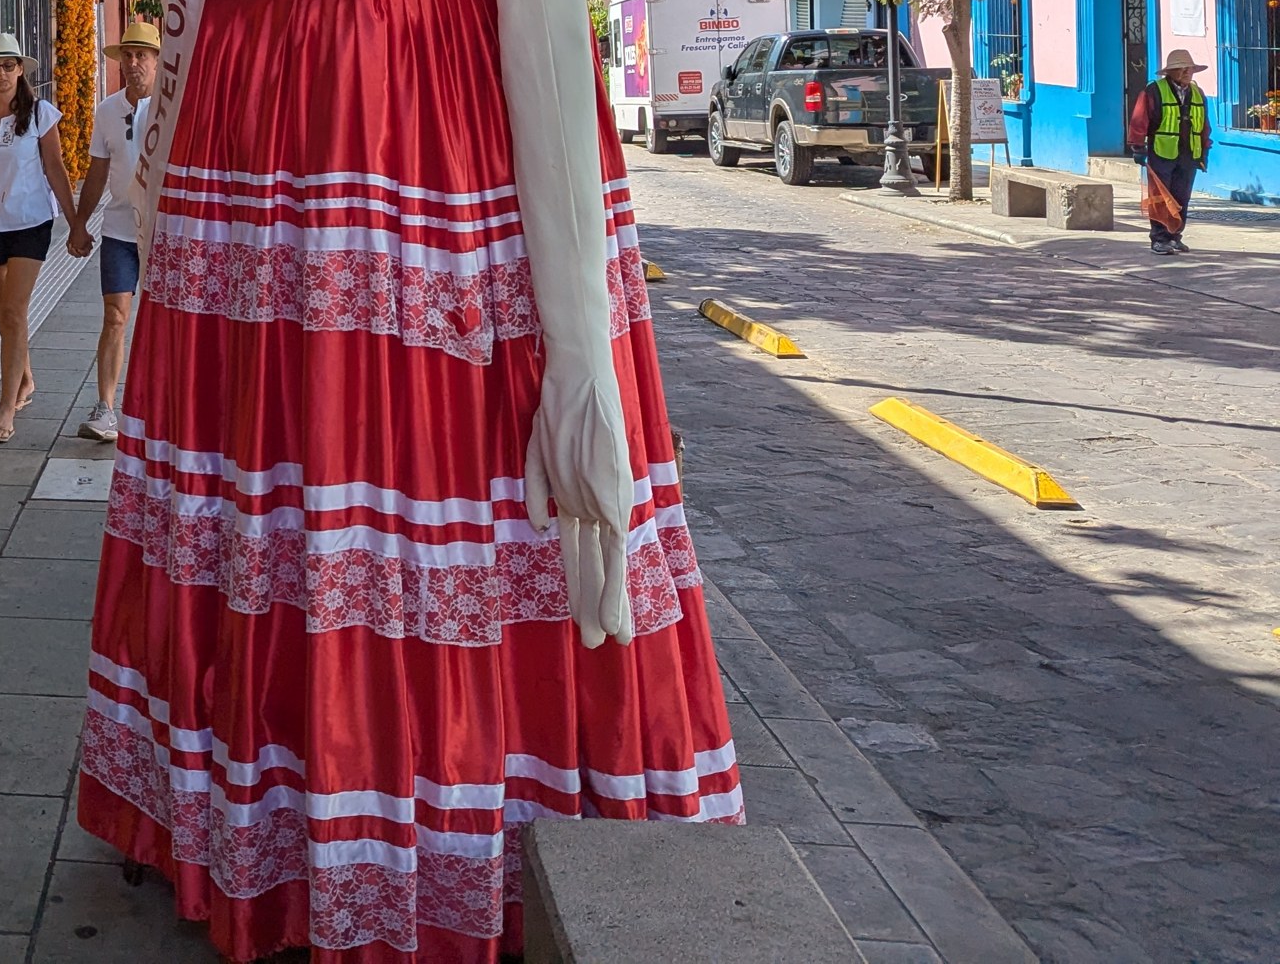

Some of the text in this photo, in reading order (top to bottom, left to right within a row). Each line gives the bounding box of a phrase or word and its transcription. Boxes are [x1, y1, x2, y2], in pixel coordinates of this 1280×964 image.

[699, 19, 740, 30] BIMBO
[695, 36, 746, 45] Entregamos
[681, 41, 750, 52] Frescura y Calid
[135, 52, 181, 190] HOTEL
